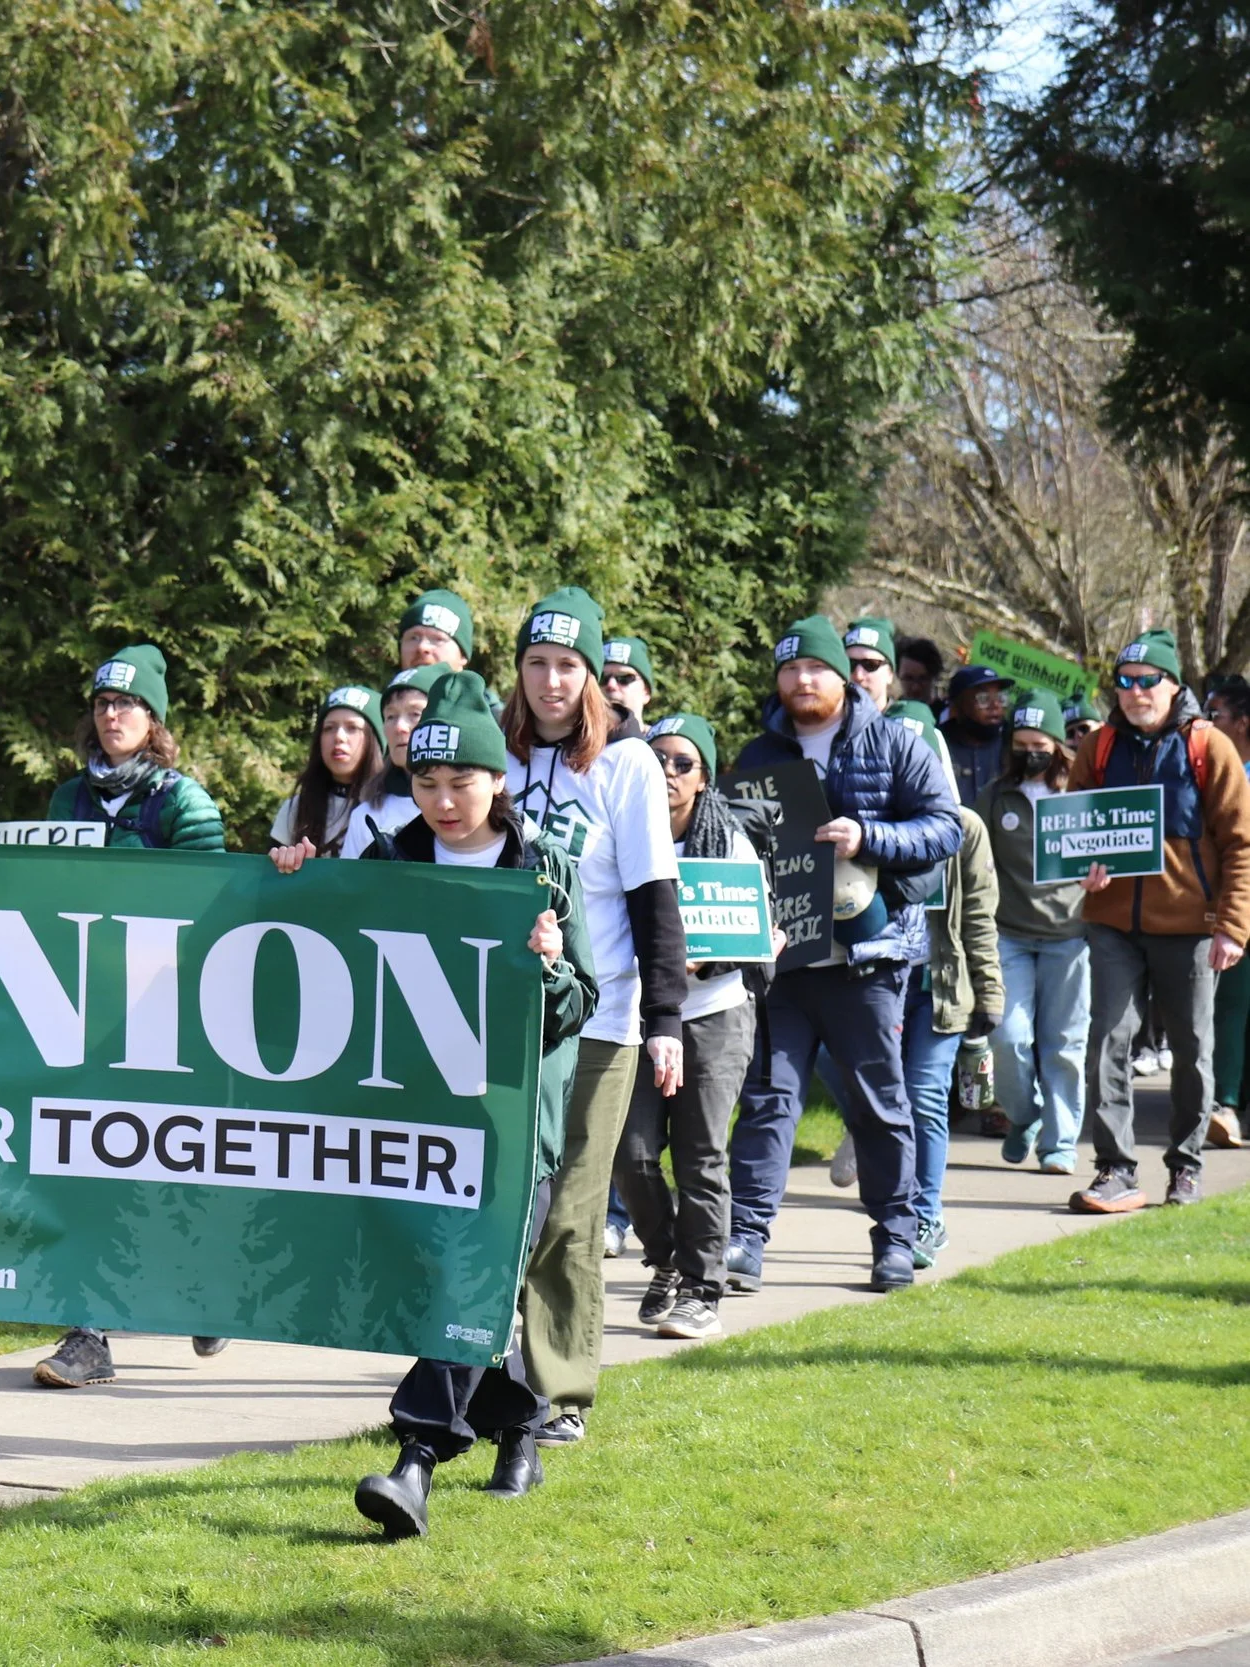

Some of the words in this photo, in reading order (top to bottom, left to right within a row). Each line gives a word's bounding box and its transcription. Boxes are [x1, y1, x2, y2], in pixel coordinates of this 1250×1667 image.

[531, 612, 580, 639] REI
[95, 661, 136, 683] REI
[1014, 707, 1045, 723] REI
[411, 724, 460, 751] REI
[734, 775, 778, 800] THE
[1040, 812, 1077, 833] REI:
[1109, 807, 1156, 826] Time
[1044, 838, 1061, 855] to
[1064, 831, 1150, 853] Negotiate.
[775, 853, 815, 877] ING
[697, 881, 760, 902] Time
[39, 1108, 477, 1199] TOGETHER.
